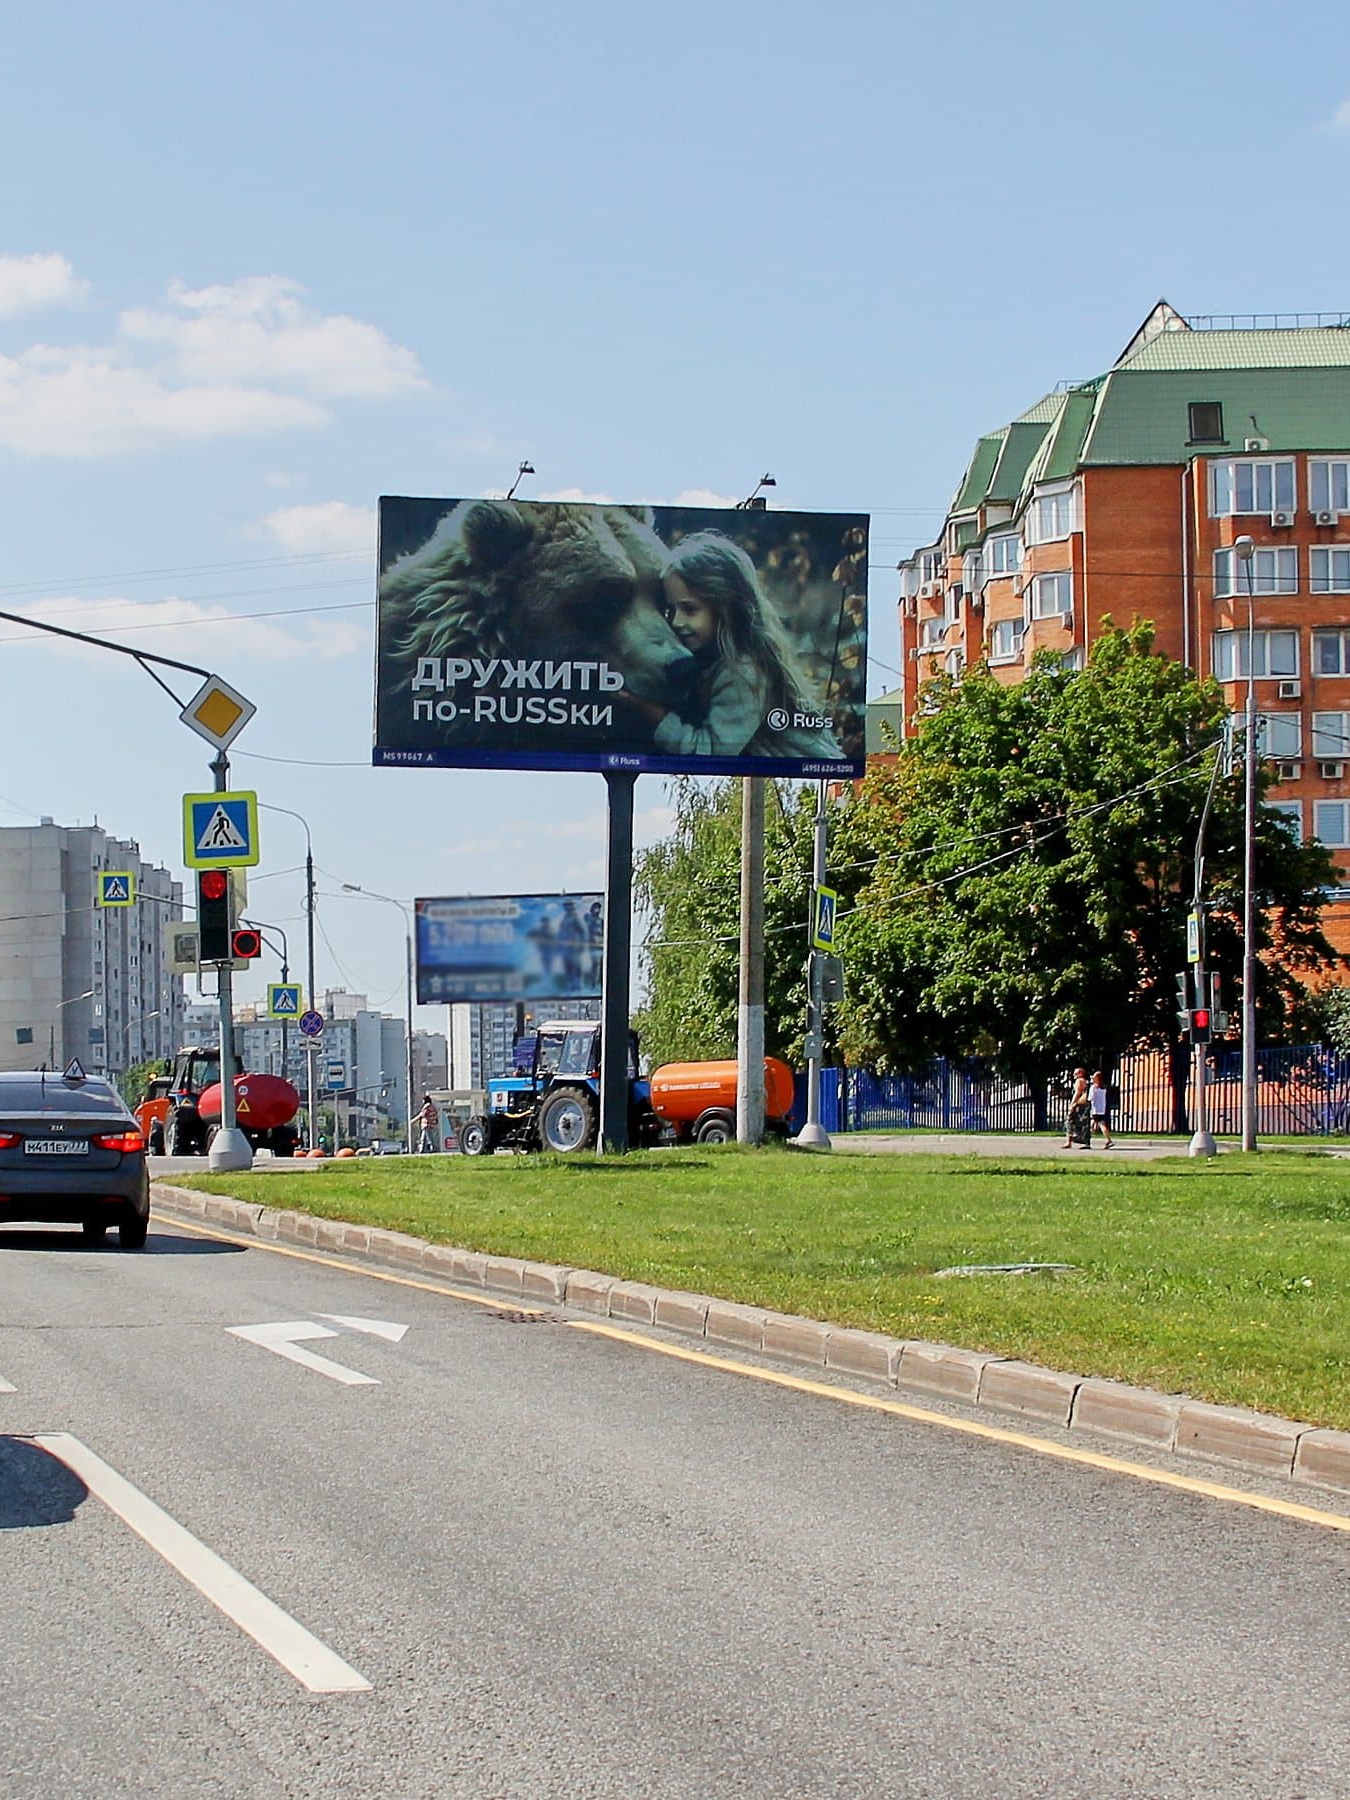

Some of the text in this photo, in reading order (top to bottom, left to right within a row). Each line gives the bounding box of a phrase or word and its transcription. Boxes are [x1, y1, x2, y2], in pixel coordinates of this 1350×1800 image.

[411, 657, 624, 692] ДРУЖИТЬ
[413, 695, 612, 726] по-RUSSки
[793, 713, 833, 728] Russ
